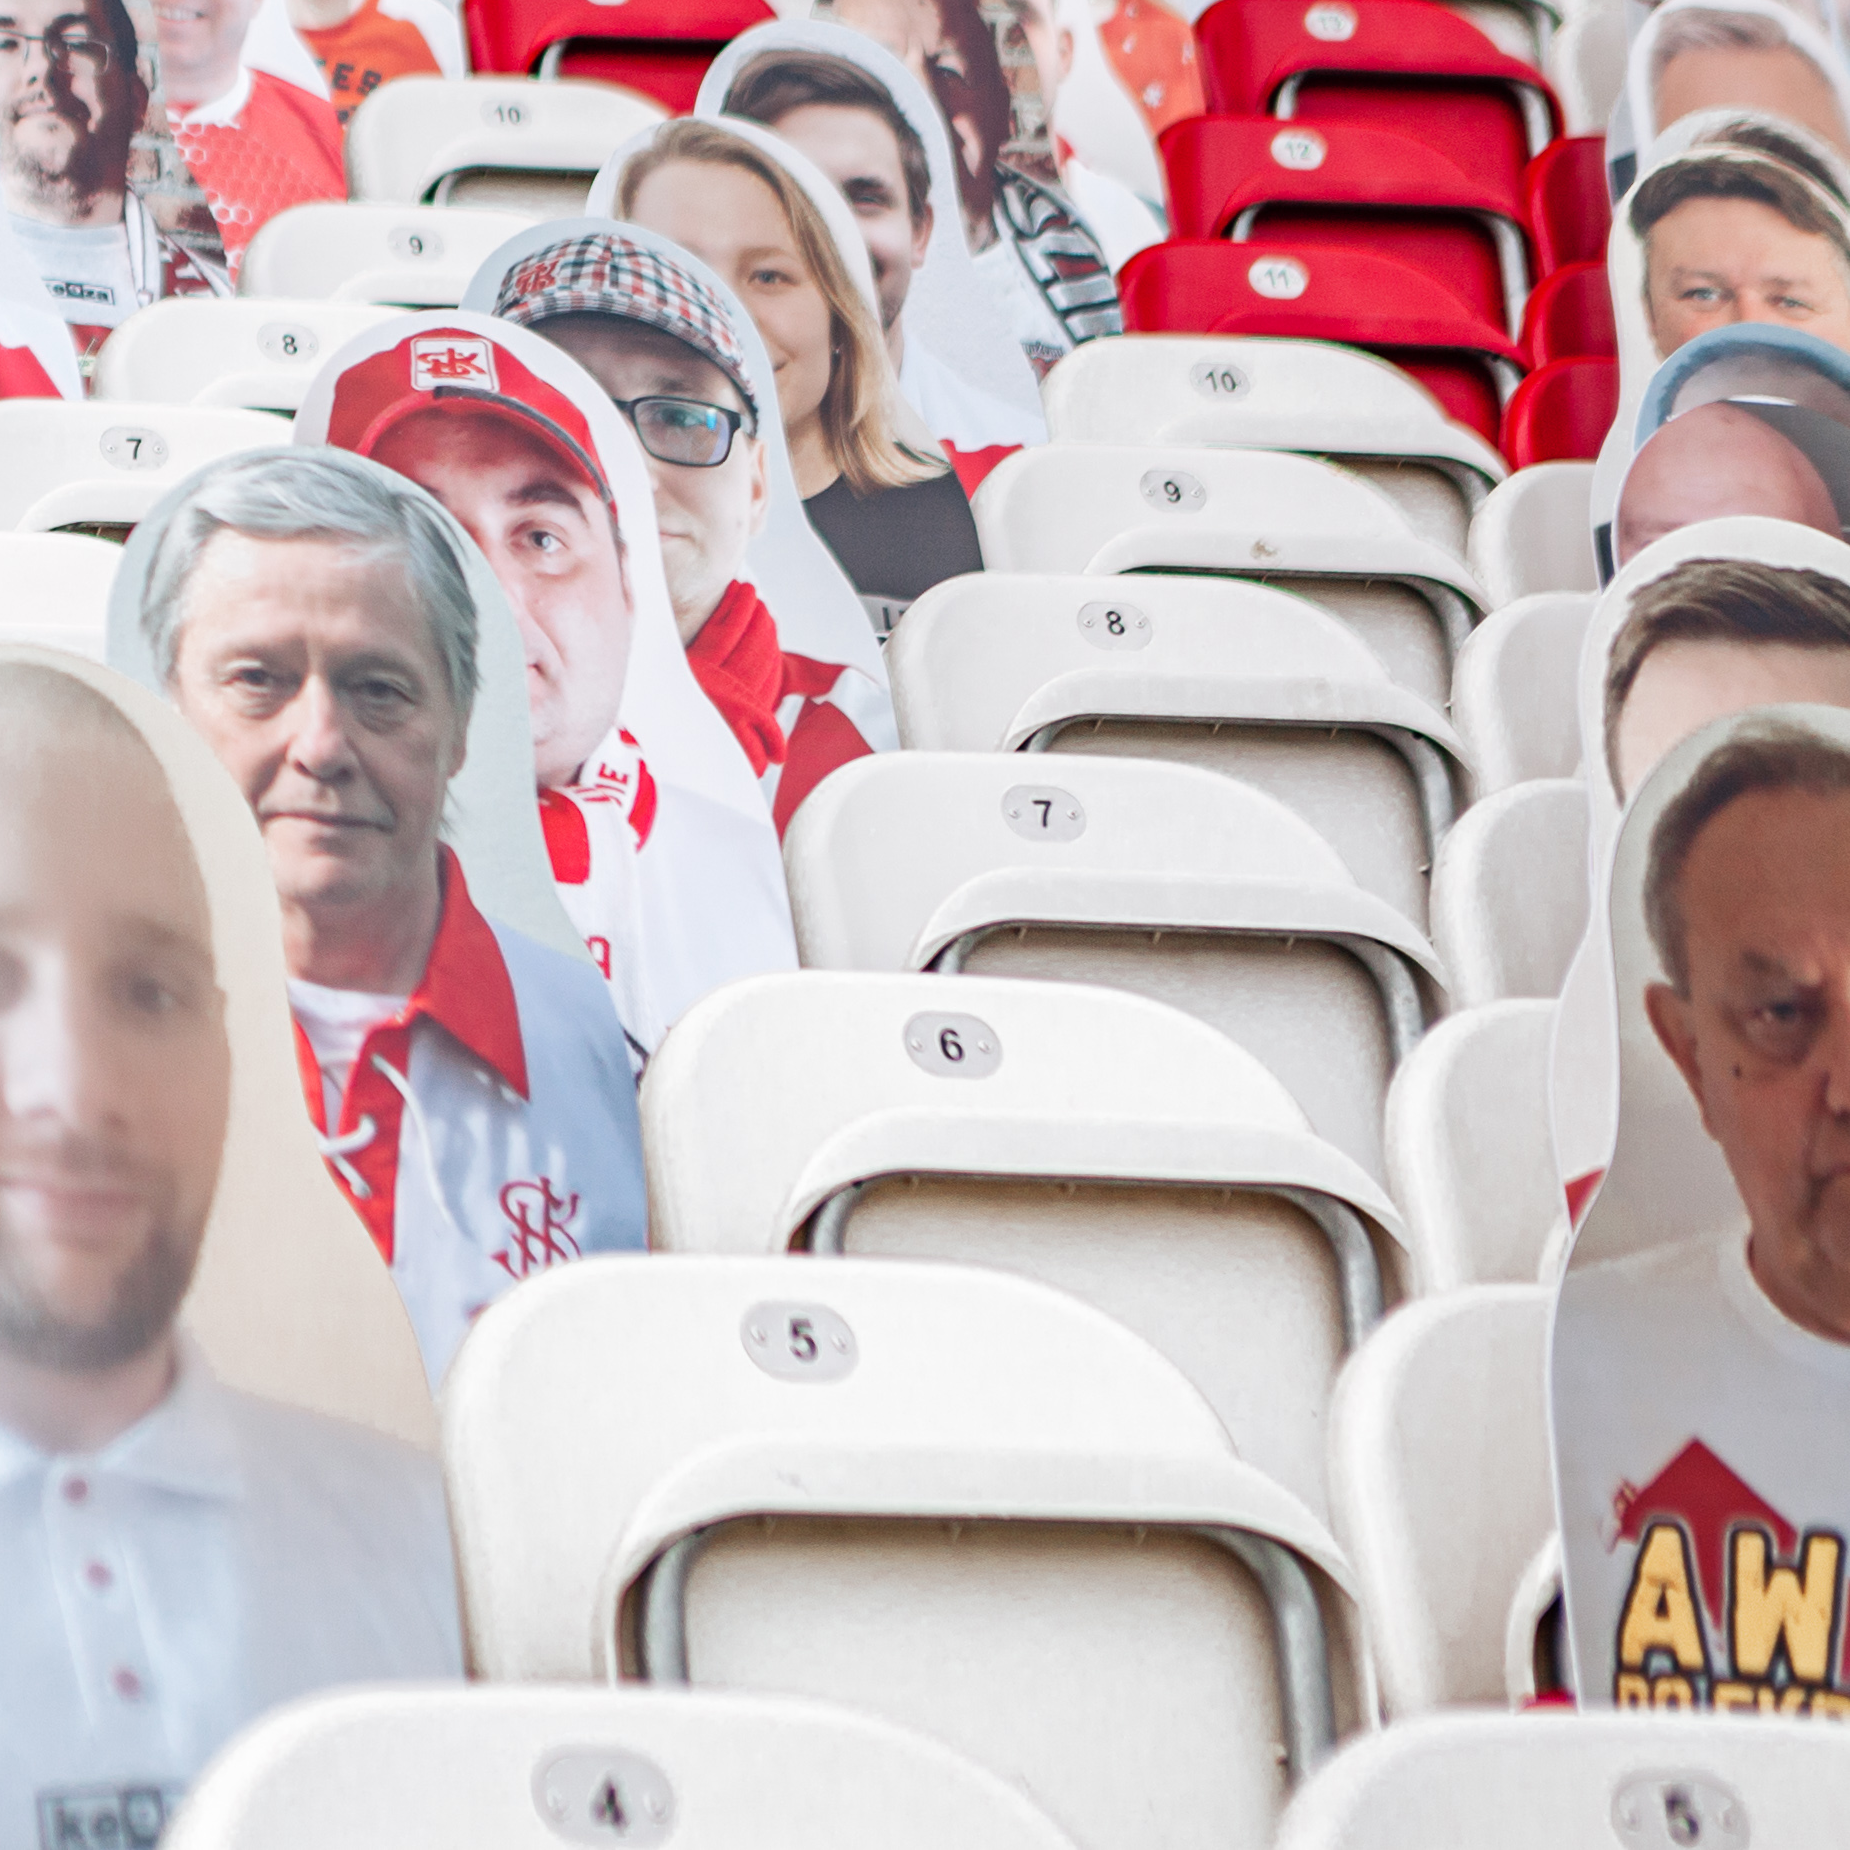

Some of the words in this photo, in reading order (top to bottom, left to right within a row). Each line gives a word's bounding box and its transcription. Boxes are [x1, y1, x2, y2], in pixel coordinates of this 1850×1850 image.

[495, 104, 522, 124] 10
[1286, 142, 1310, 159] 12
[409, 235, 424, 254] 9
[1264, 268, 1290, 287] 11
[282, 333, 299, 355] 8
[1205, 370, 1239, 392] 10
[126, 437, 143, 460] 7
[1163, 480, 1182, 503] 9
[1105, 610, 1126, 636] 8
[1032, 799, 1052, 828] 7
[939, 1028, 964, 1061] 6
[786, 1315, 819, 1361] 5
[594, 1780, 628, 1834] 4
